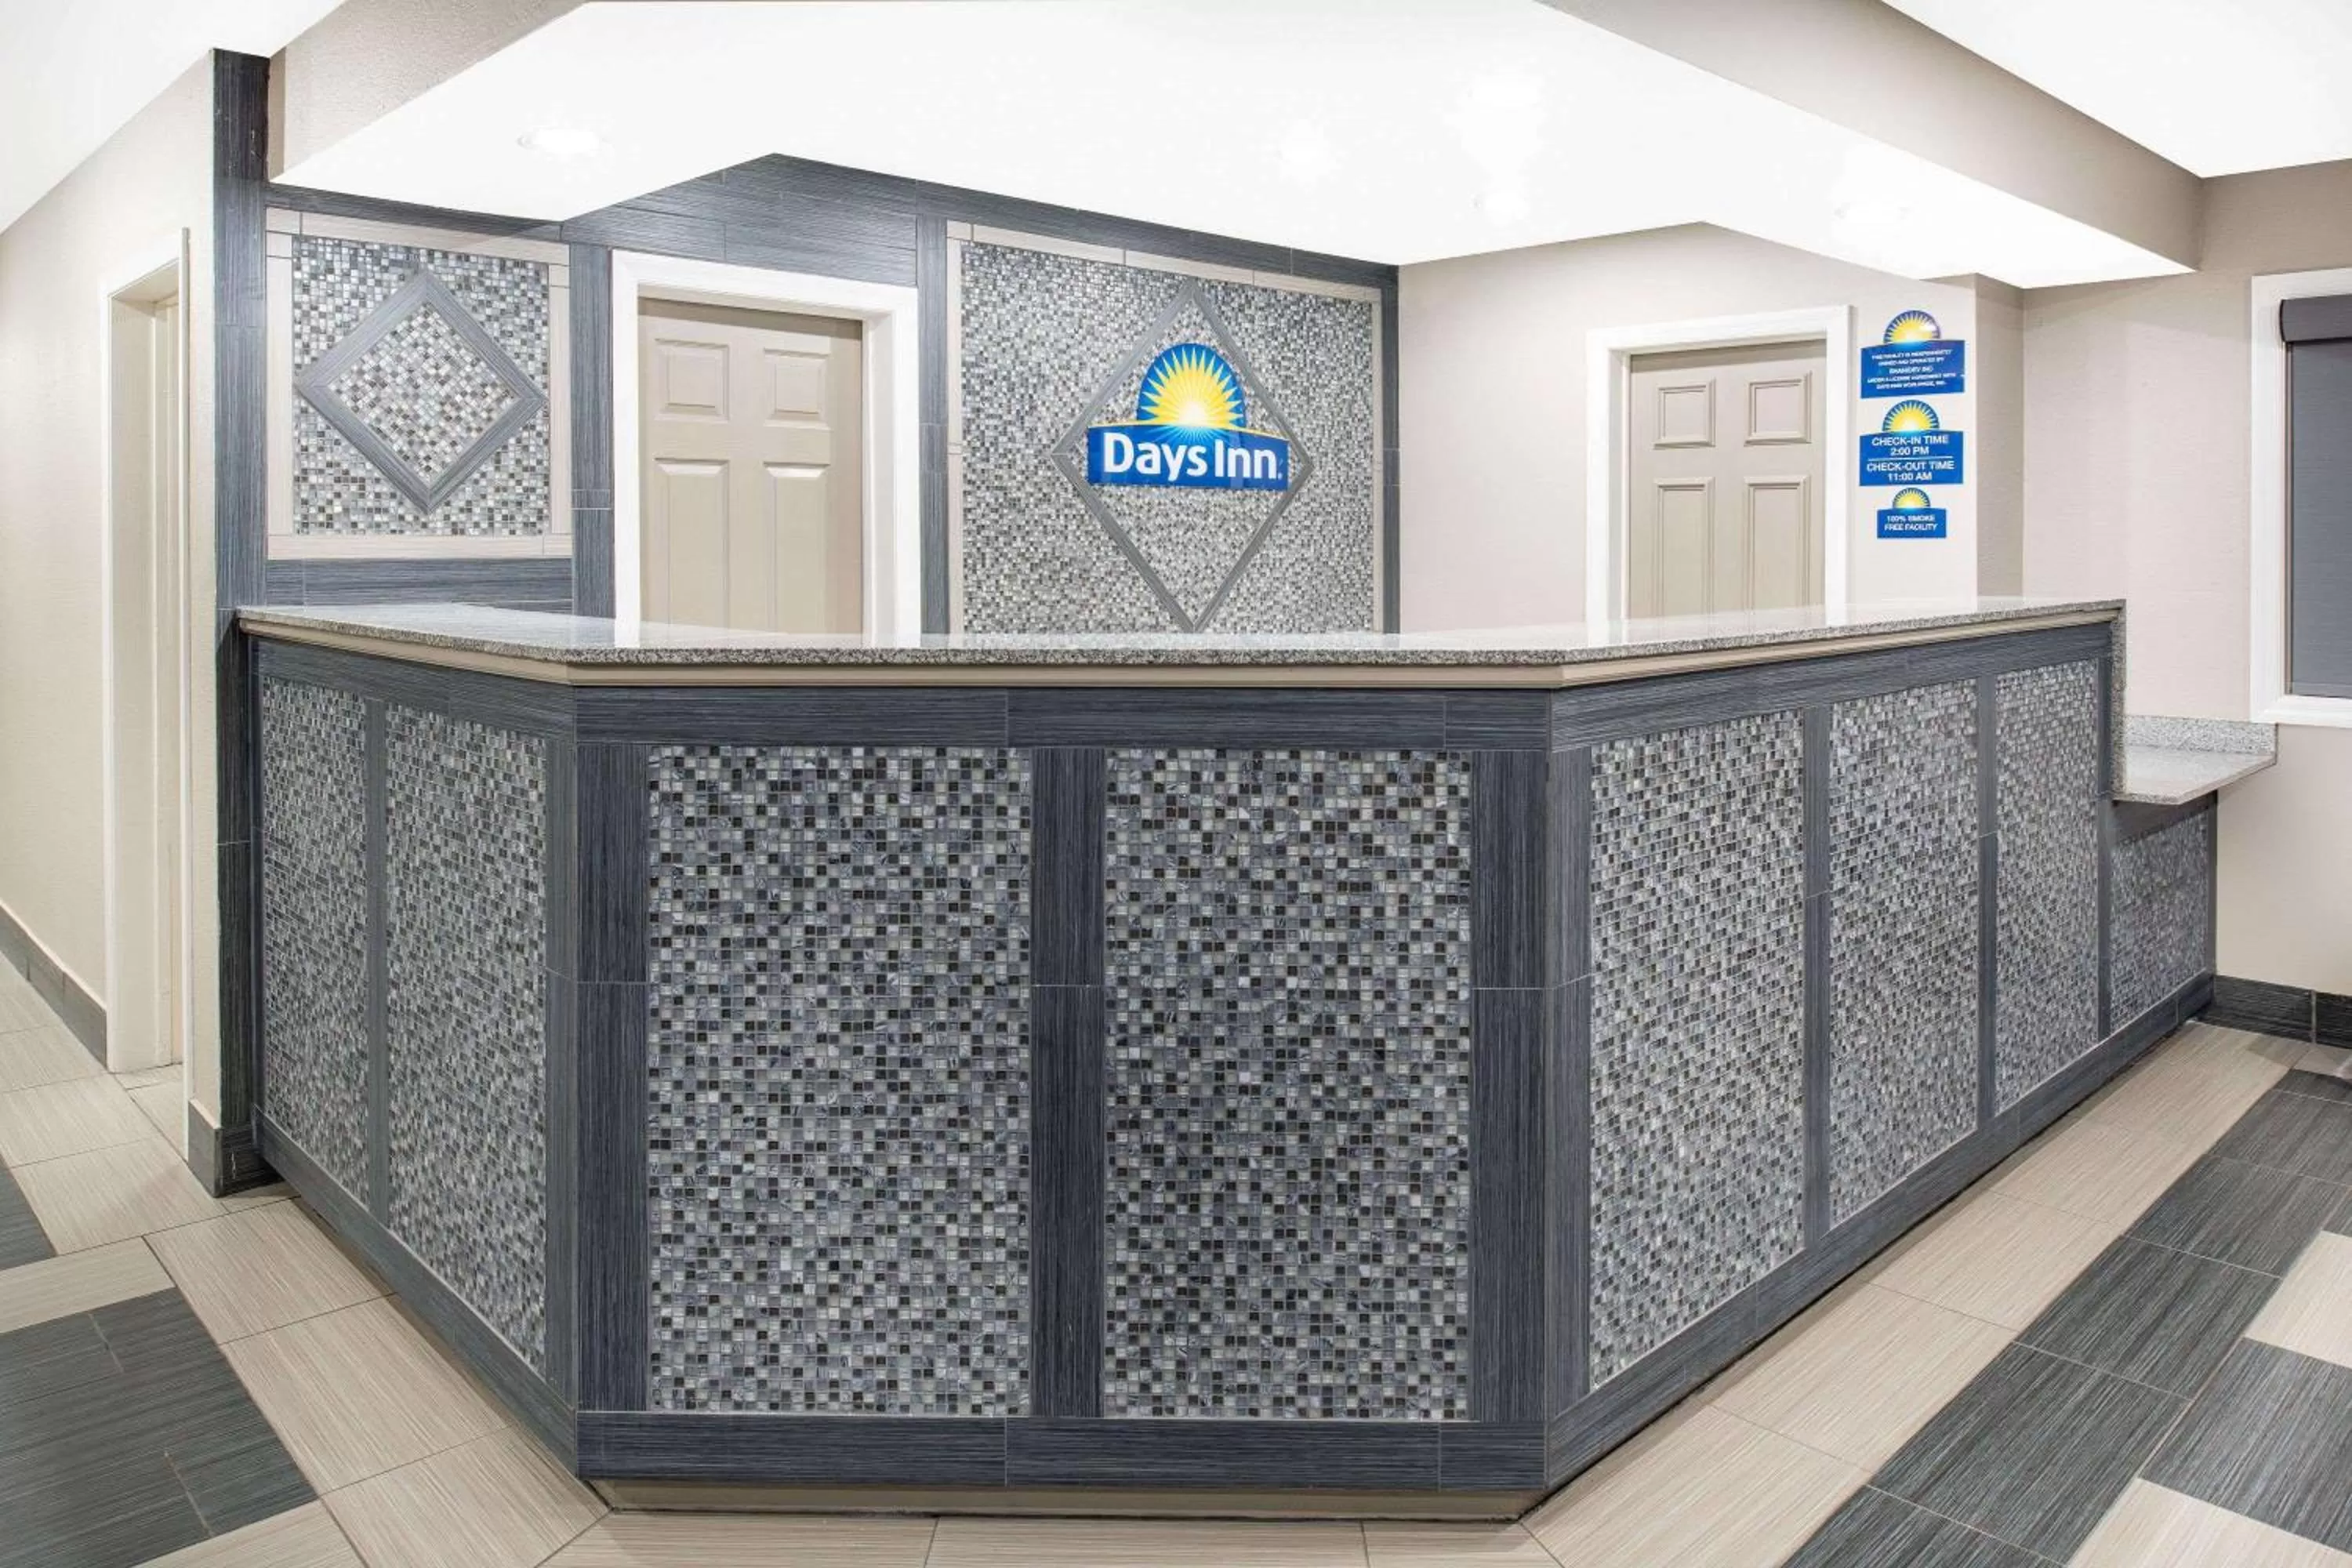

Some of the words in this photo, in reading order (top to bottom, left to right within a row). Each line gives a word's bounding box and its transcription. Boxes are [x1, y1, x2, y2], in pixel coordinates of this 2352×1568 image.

[1871, 437, 1922, 446] CHECK-IN
[1925, 435, 1949, 445] TIME
[1103, 432, 1208, 481] Days
[1890, 447, 1911, 456] 2:00
[1912, 446, 1929, 455] PM
[1867, 462, 1926, 471] CHECK-OUT
[1929, 460, 1955, 470] TIME
[1888, 473, 1913, 481] 11:00
[1915, 472, 1933, 481] AM
